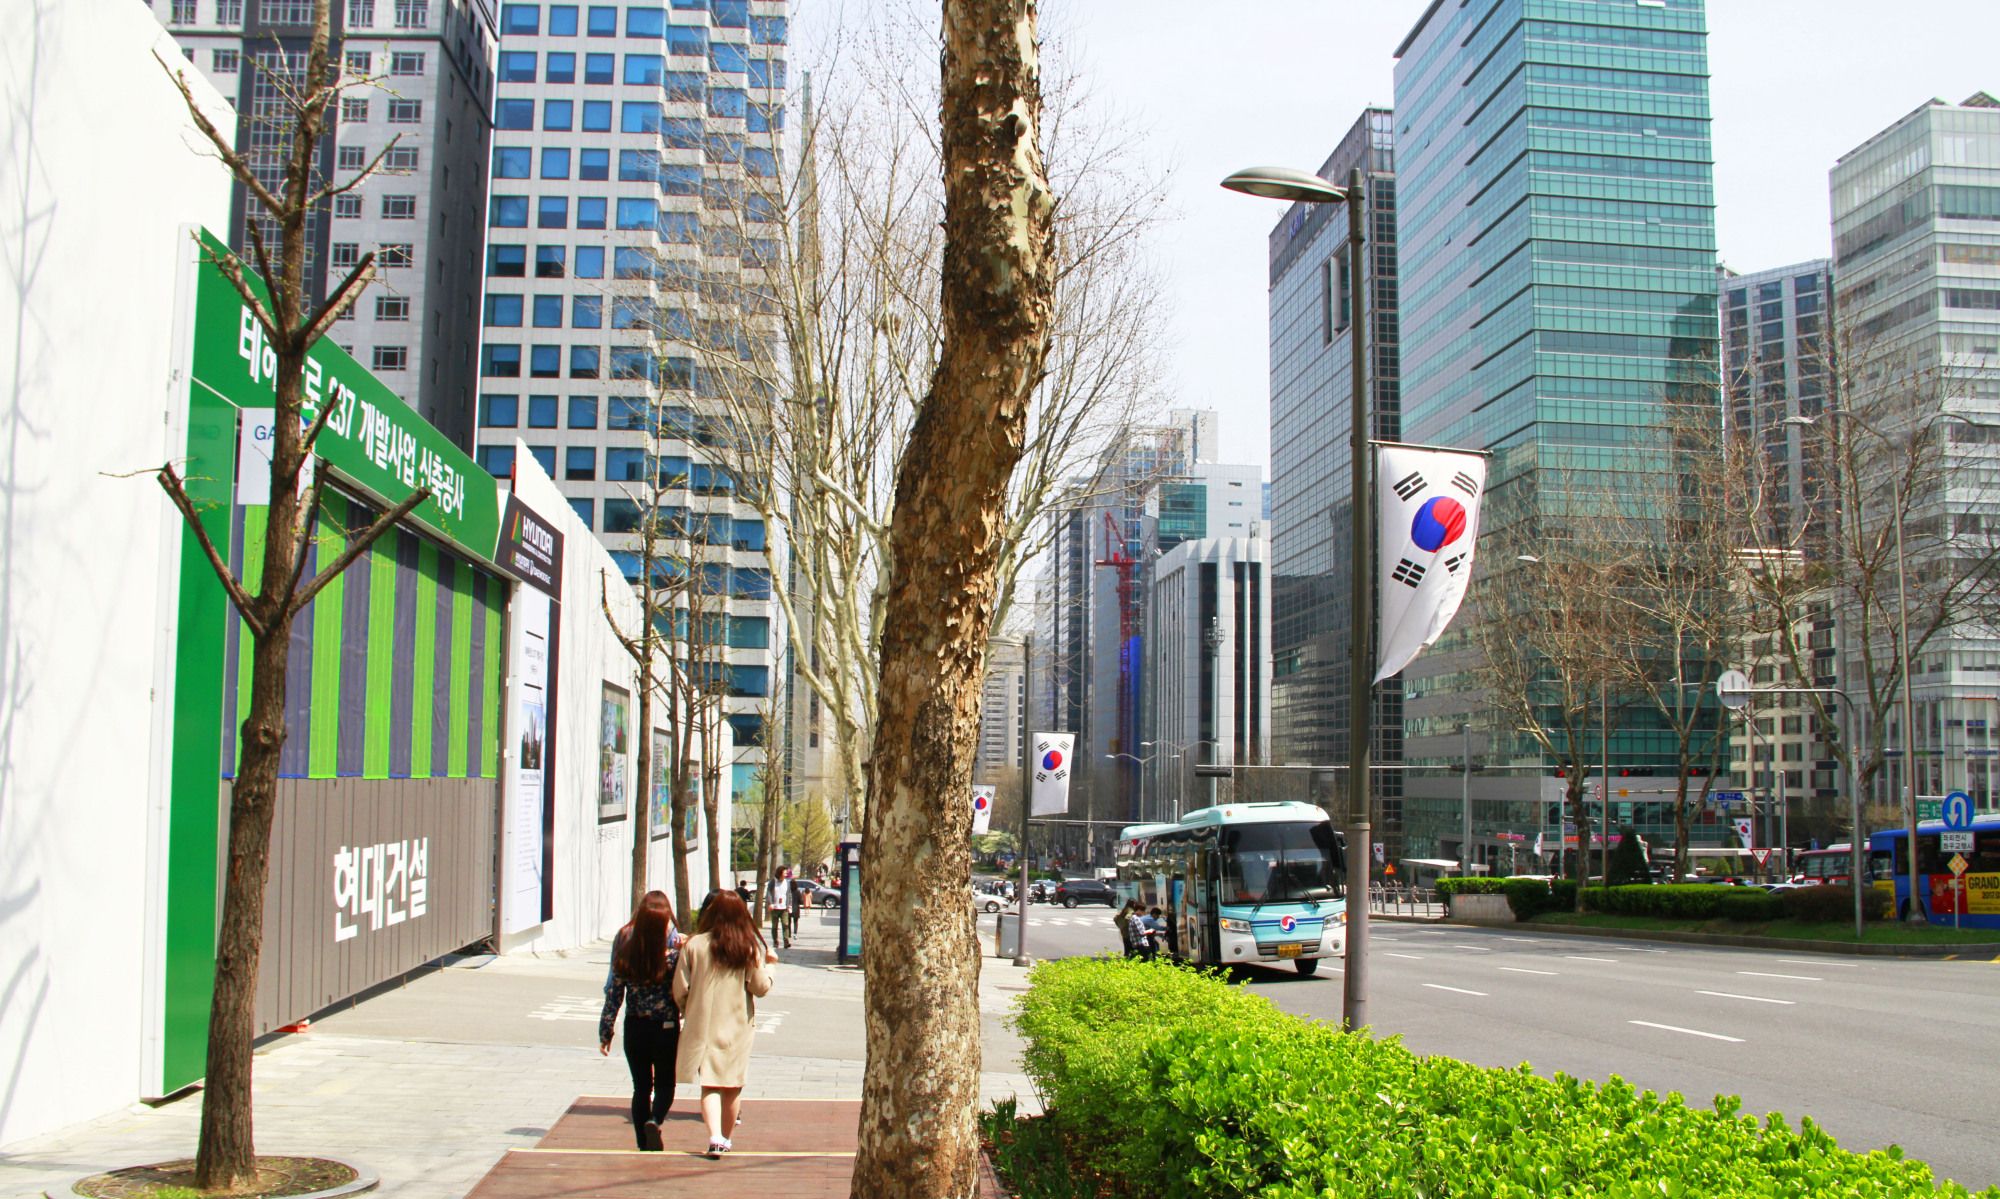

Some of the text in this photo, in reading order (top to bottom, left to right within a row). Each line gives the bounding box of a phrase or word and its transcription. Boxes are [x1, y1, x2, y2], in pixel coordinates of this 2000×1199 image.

[326, 376, 356, 440] 237
[358, 400, 417, 489] 개발사업
[419, 446, 465, 522] 신축공사
[522, 514, 554, 557] HYUNDAI
[333, 837, 428, 942] 현대건설
[1968, 876, 1999, 890] GRAND
